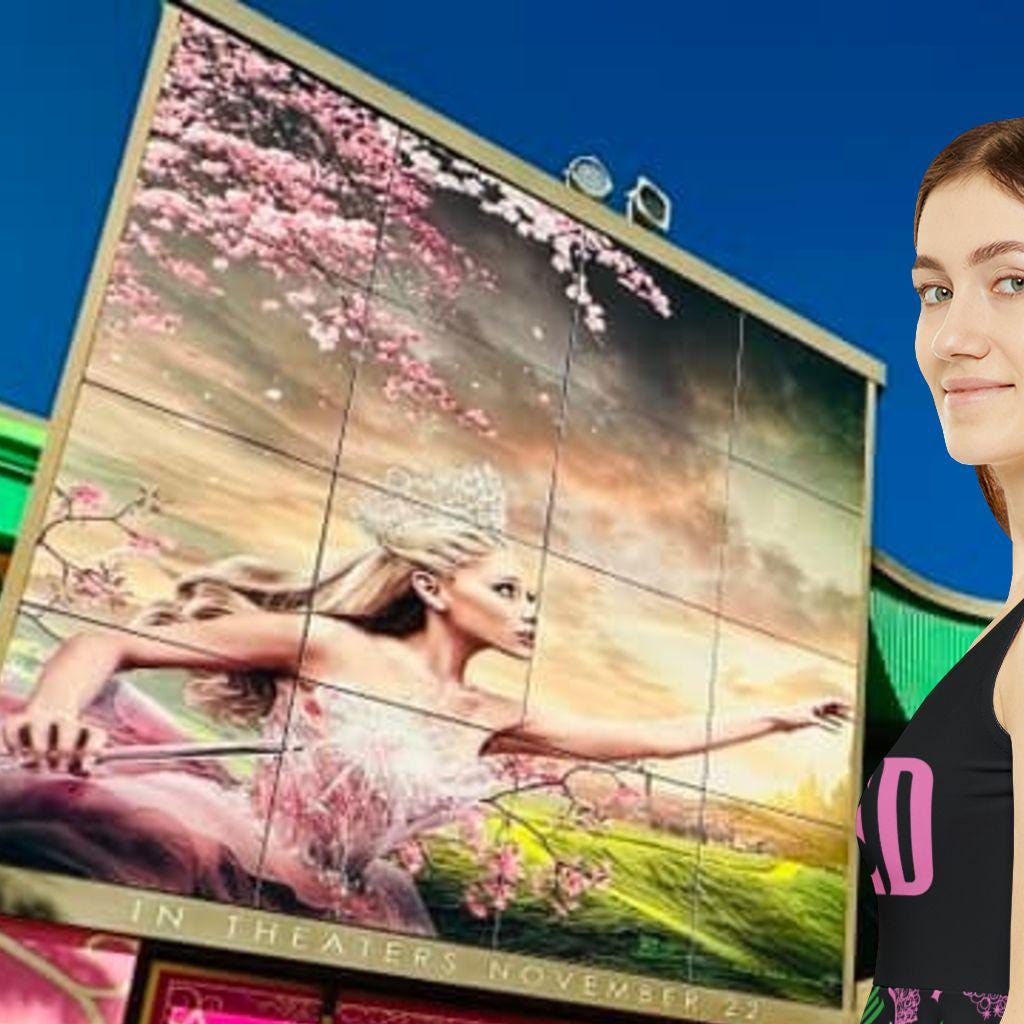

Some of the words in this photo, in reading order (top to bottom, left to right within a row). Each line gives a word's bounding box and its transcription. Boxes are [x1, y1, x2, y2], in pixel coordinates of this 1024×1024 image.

[131, 898, 184, 928] IN
[228, 914, 456, 974] THEATERS
[487, 960, 699, 1015] NOVEMBER
[724, 1000, 760, 1020] 22
